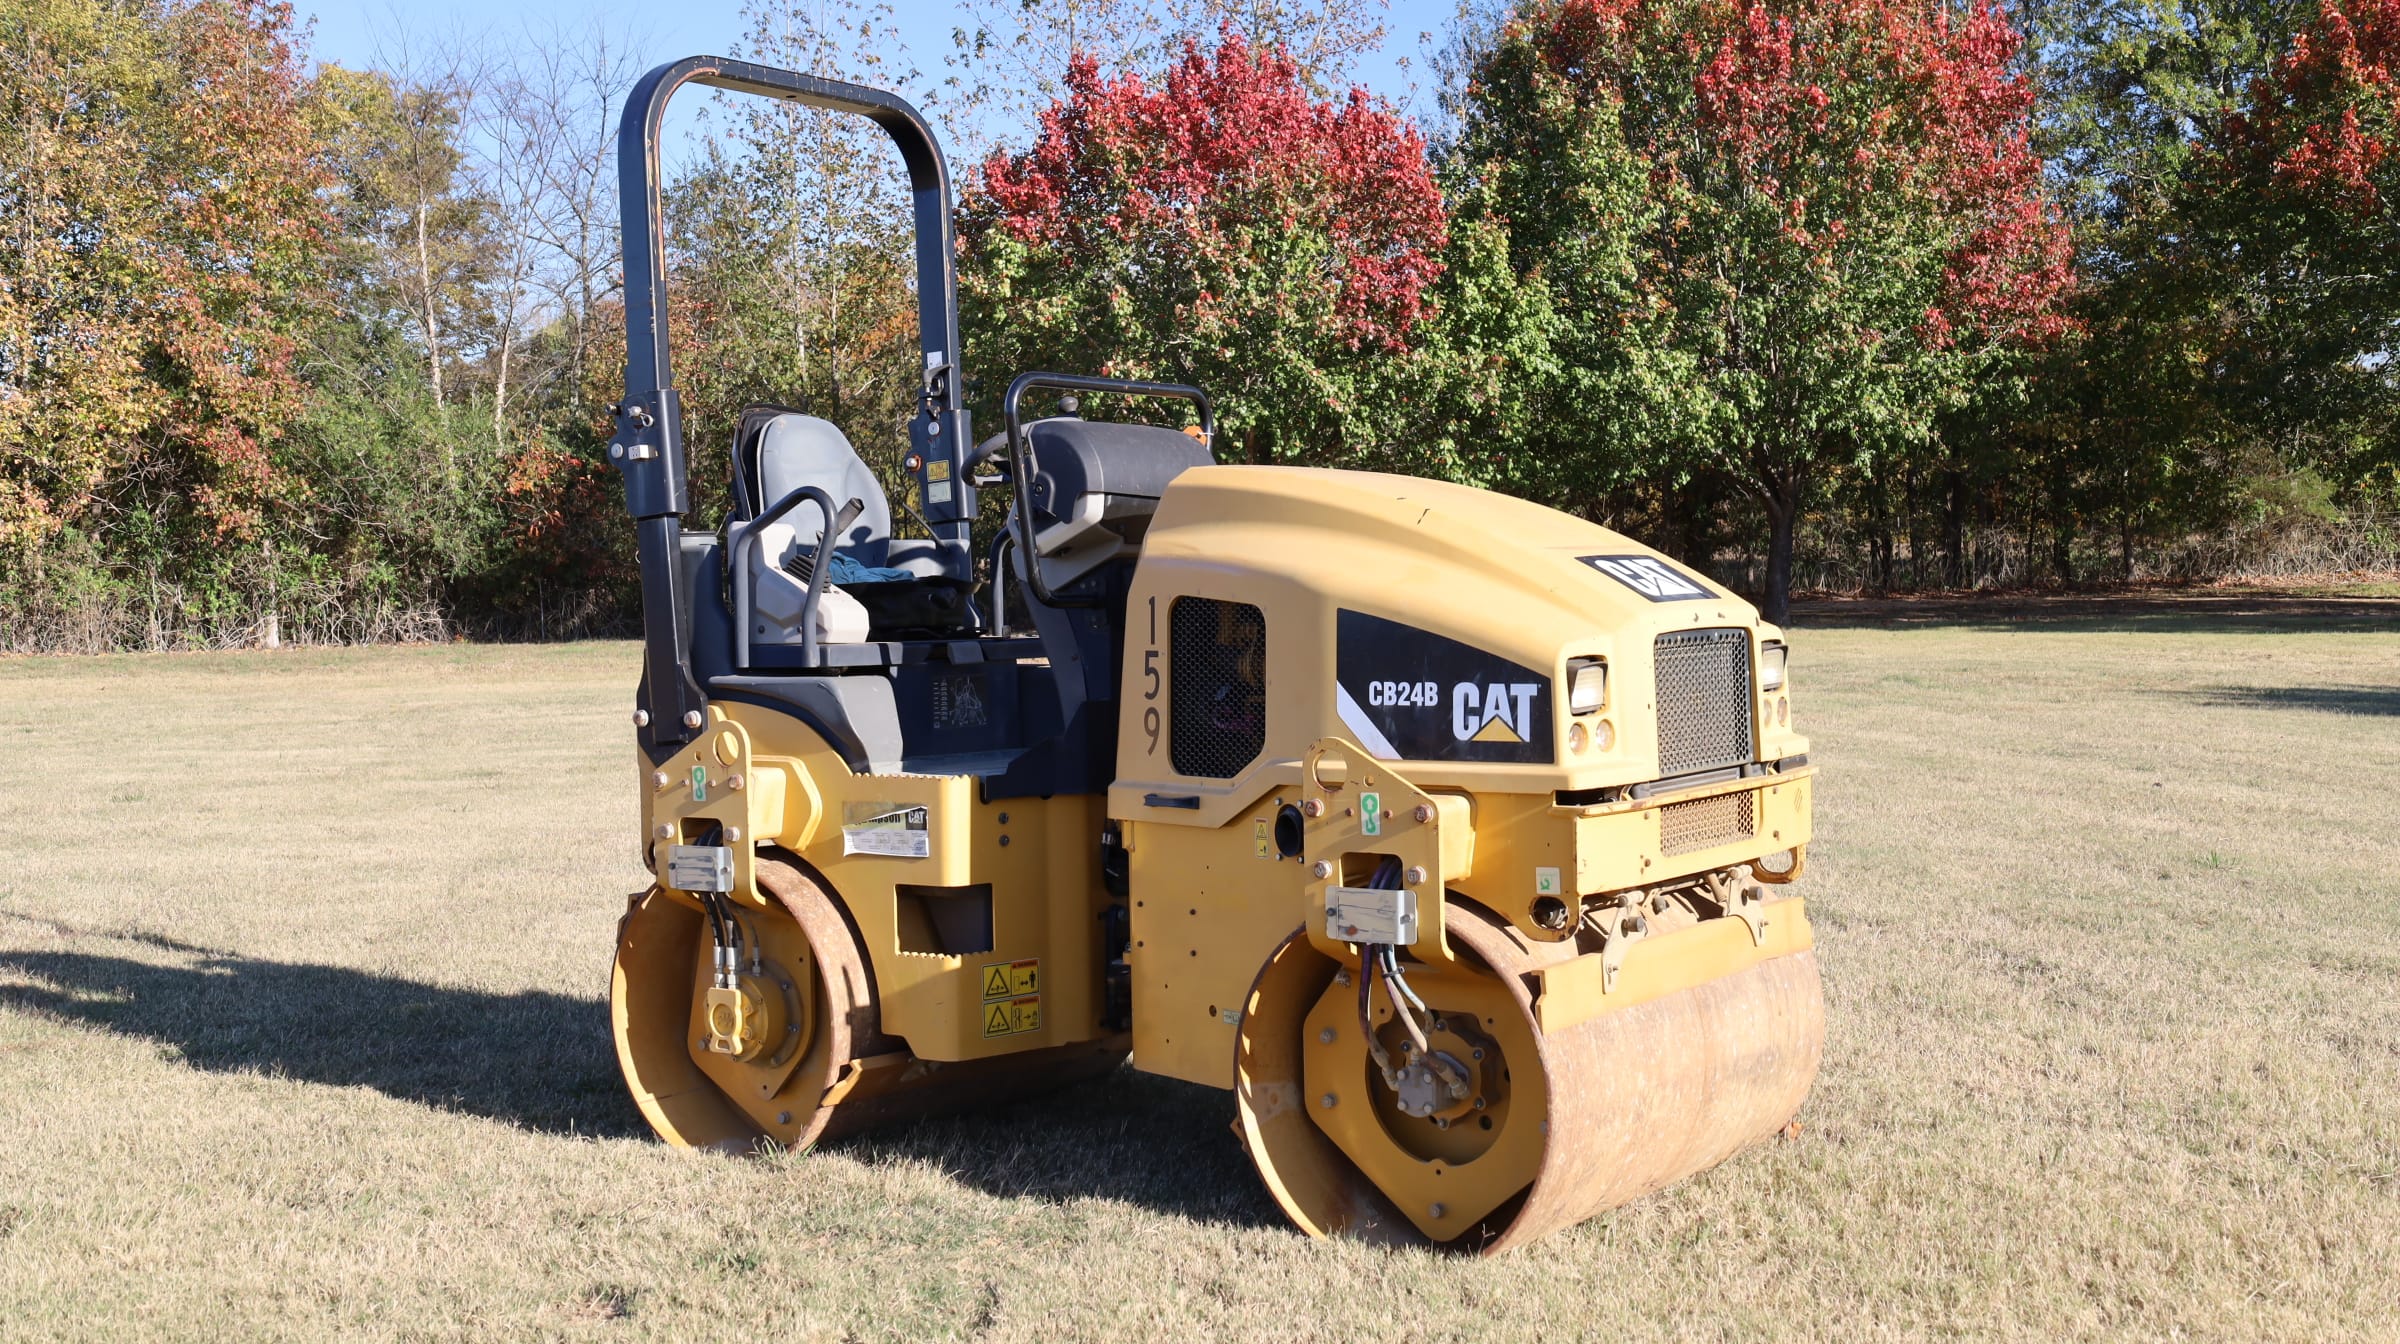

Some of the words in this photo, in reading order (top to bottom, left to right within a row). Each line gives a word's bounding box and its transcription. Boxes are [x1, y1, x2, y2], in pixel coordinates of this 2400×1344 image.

[1594, 559, 1704, 596] CAT
[1144, 596, 1161, 757] 159
[1368, 681, 1439, 707] CB24B
[1452, 682, 1538, 743] CAT
[908, 810, 925, 823] CAT
